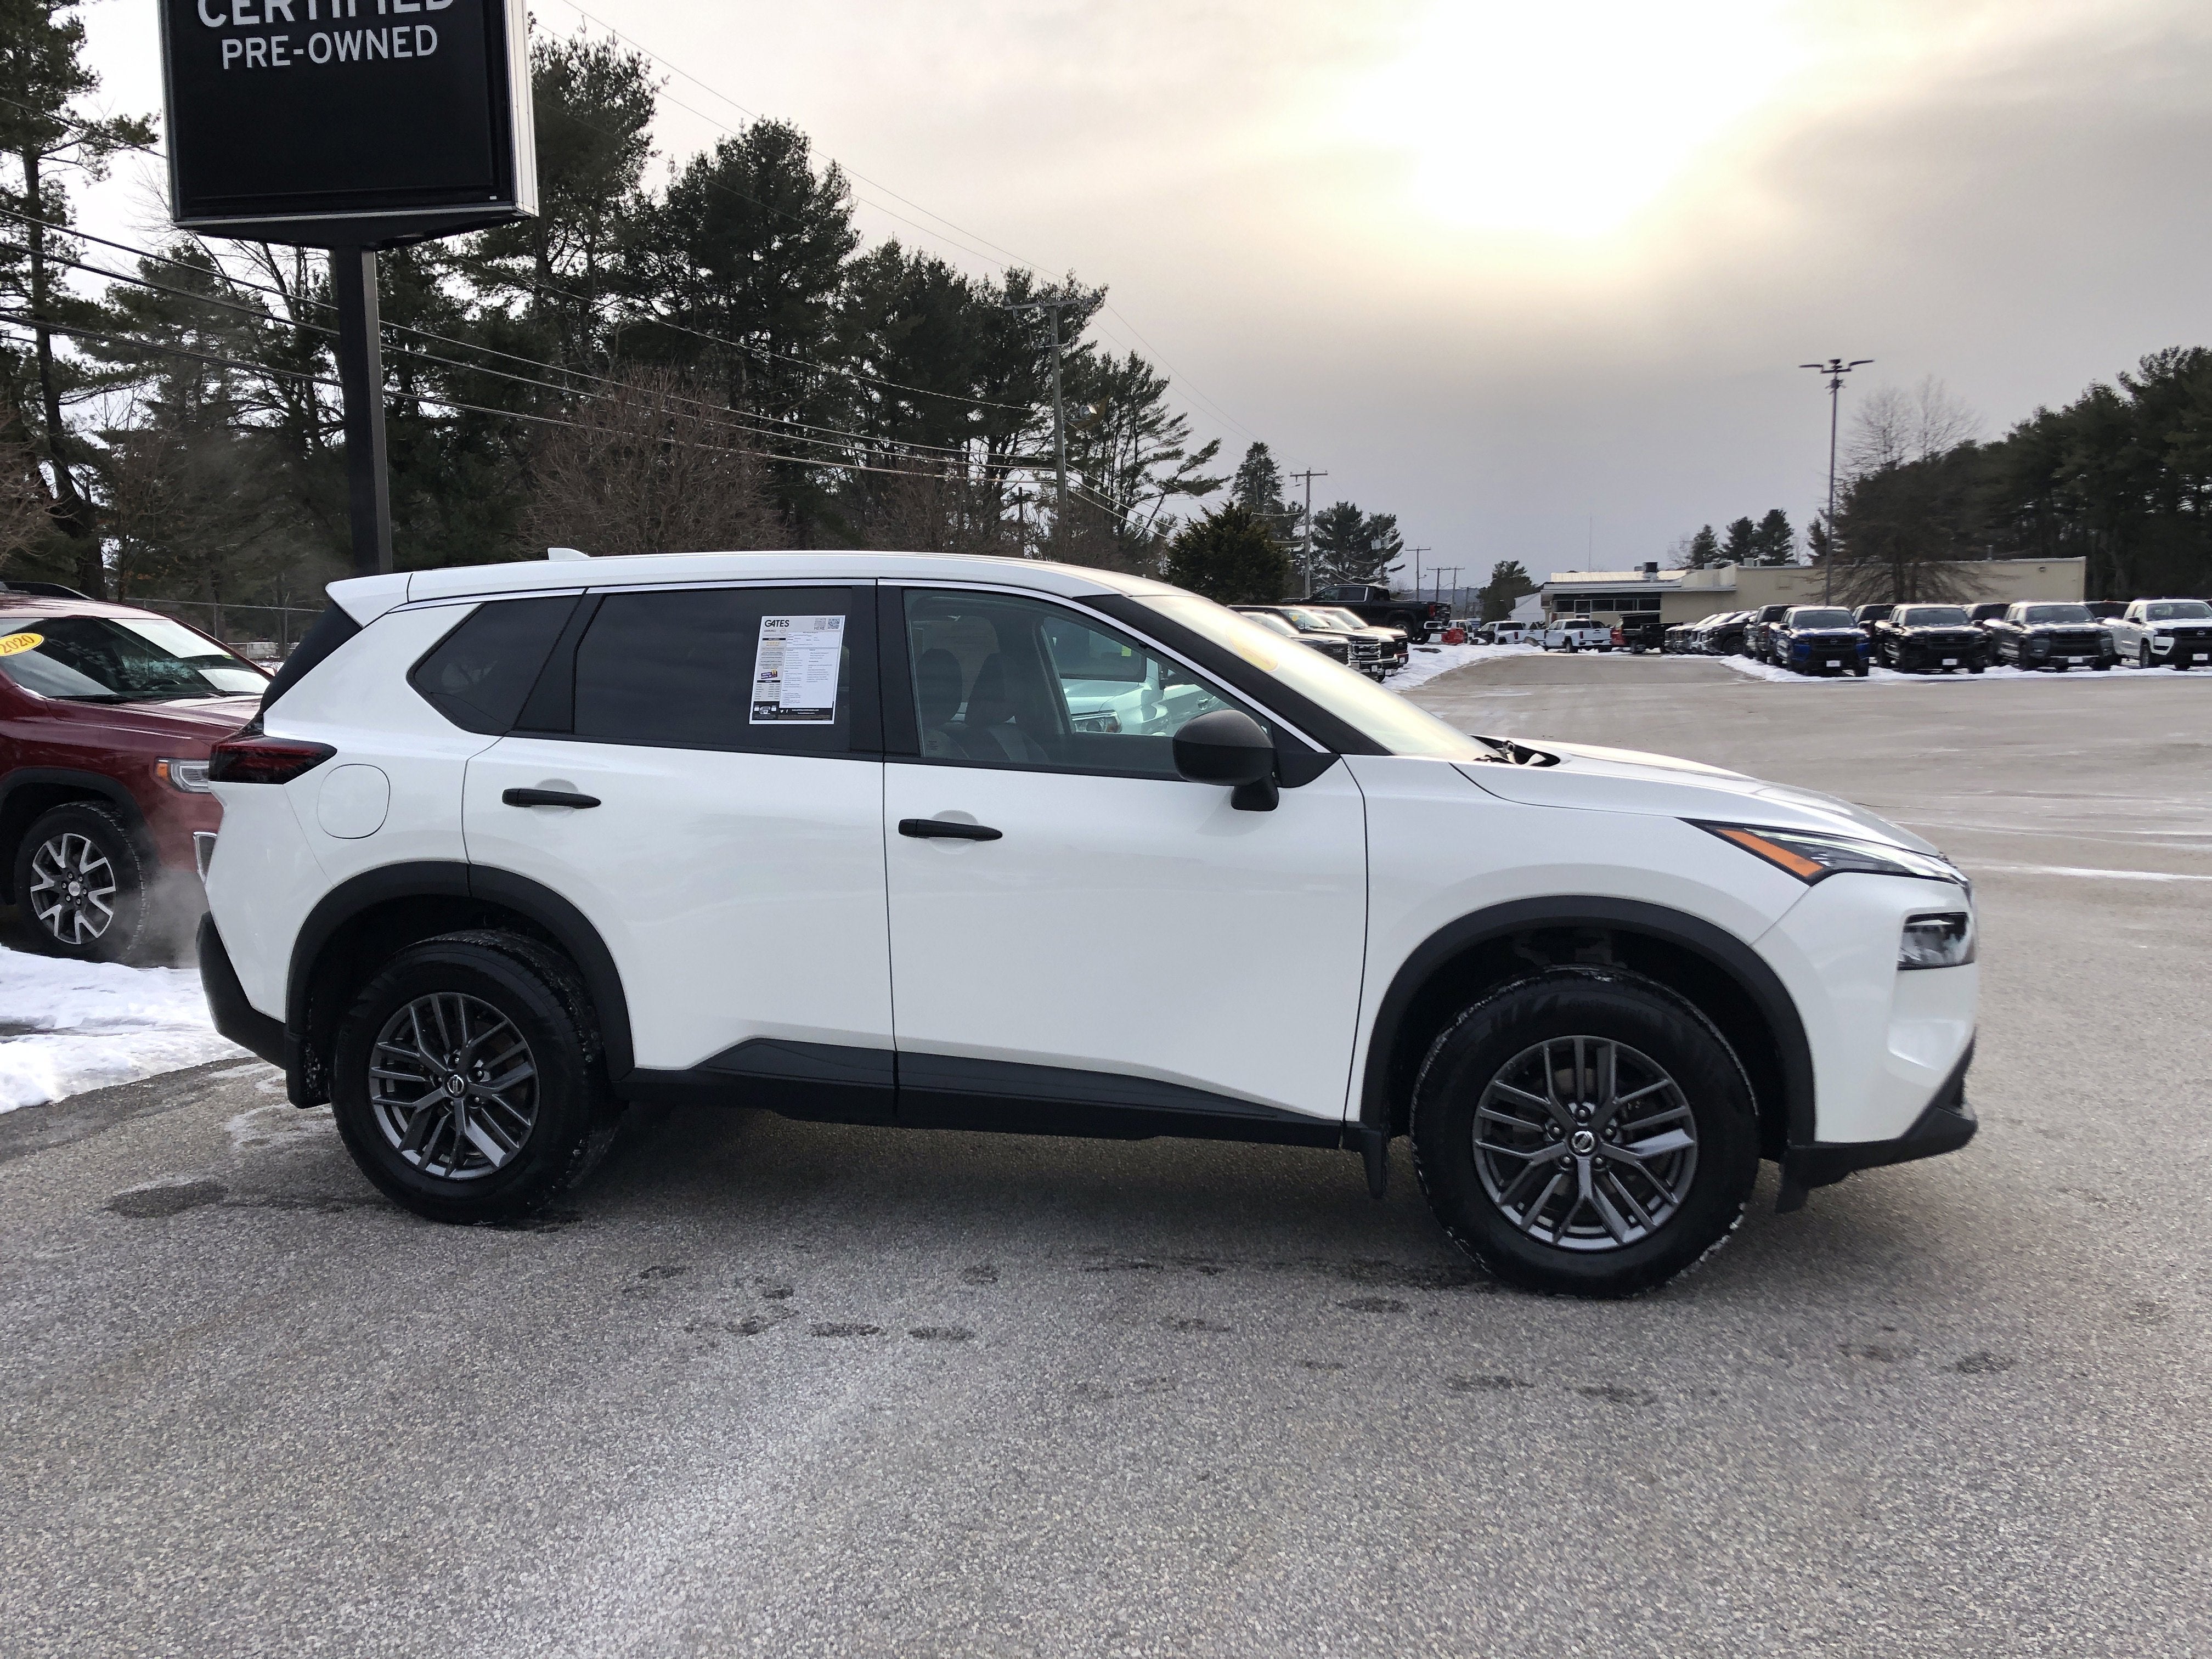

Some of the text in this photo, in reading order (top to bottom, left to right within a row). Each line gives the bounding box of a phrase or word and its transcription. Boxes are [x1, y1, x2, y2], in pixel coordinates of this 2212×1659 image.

[222, 25, 438, 70] PRE-OWNED
[764, 619, 789, 628] GATES
[0, 635, 35, 653] 2020
